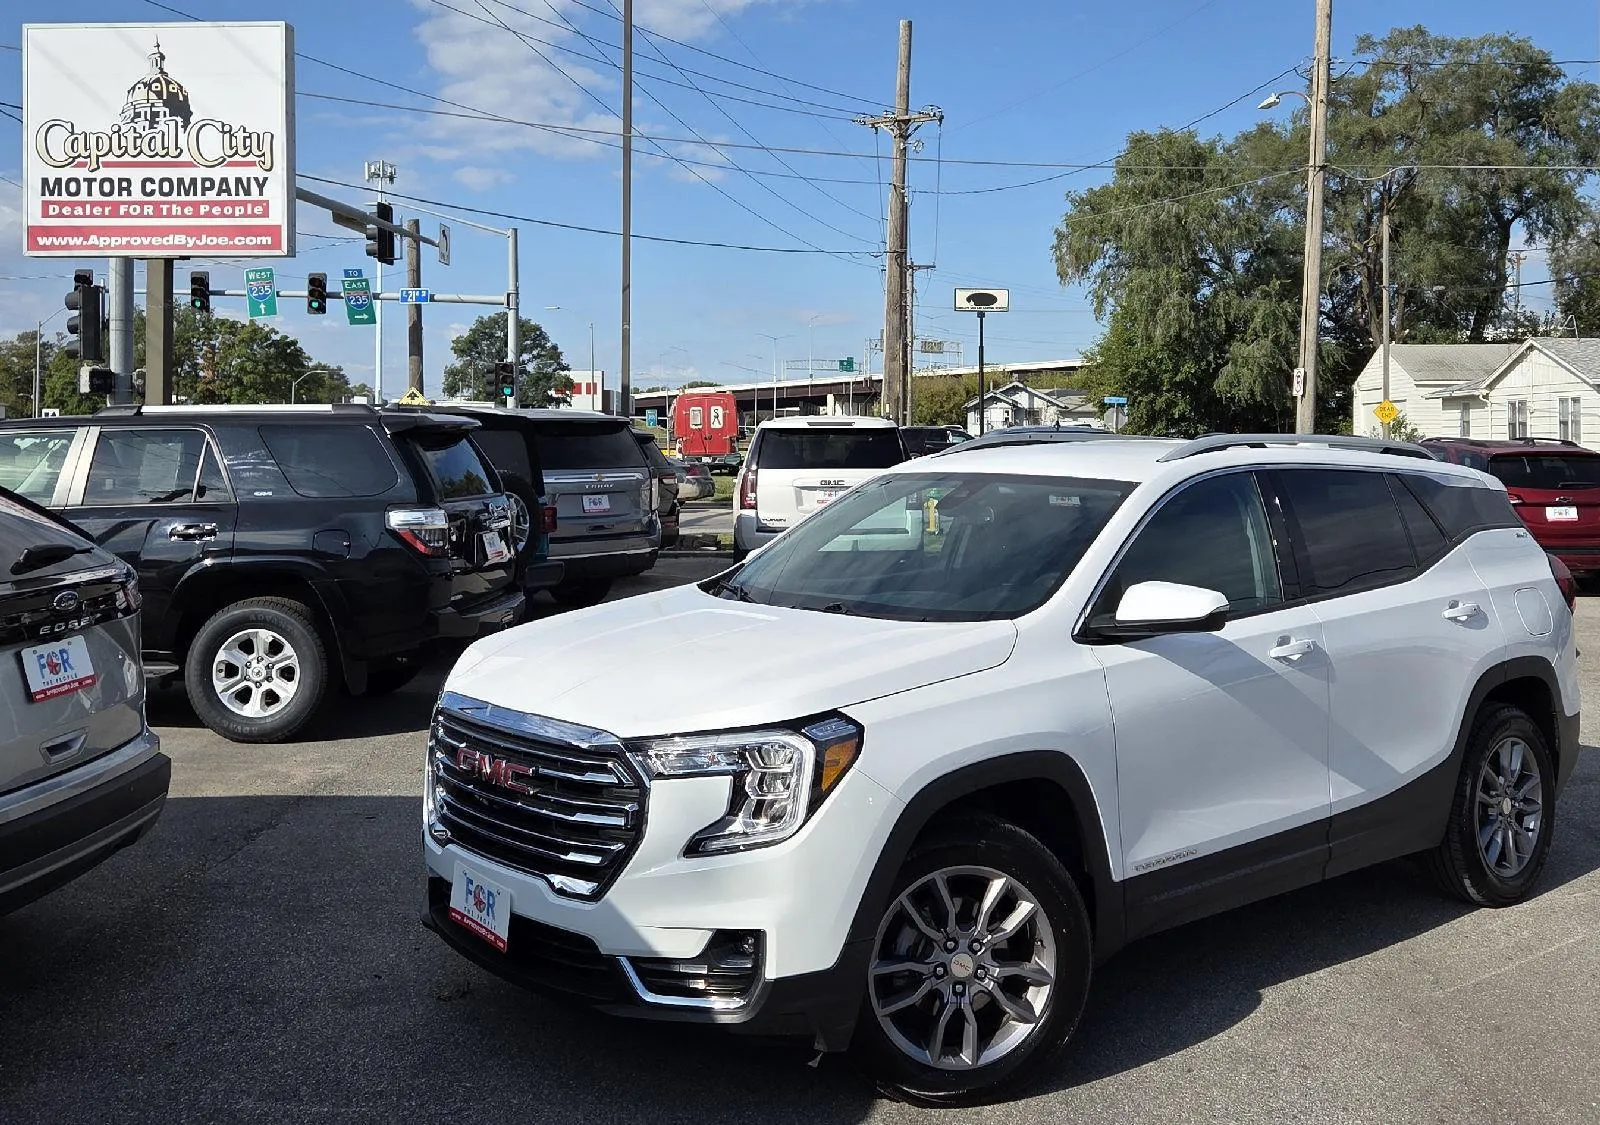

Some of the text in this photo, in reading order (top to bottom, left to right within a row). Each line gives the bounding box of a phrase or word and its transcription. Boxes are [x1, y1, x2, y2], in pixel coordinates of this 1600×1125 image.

[36, 119, 274, 172] Capital City
[40, 176, 268, 197] MOTOR COMPANY
[48, 203, 264, 217] Dealer FOR The People
[36, 234, 272, 248] www.ApprovedByJoe.com
[248, 271, 272, 280] WEST
[252, 285, 272, 297] 235
[344, 281, 367, 289] EAST
[349, 295, 369, 305] 235
[40, 616, 91, 635] EDGE
[36, 648, 76, 679] FOR
[456, 747, 536, 796] GMC
[465, 876, 496, 922] FOR
